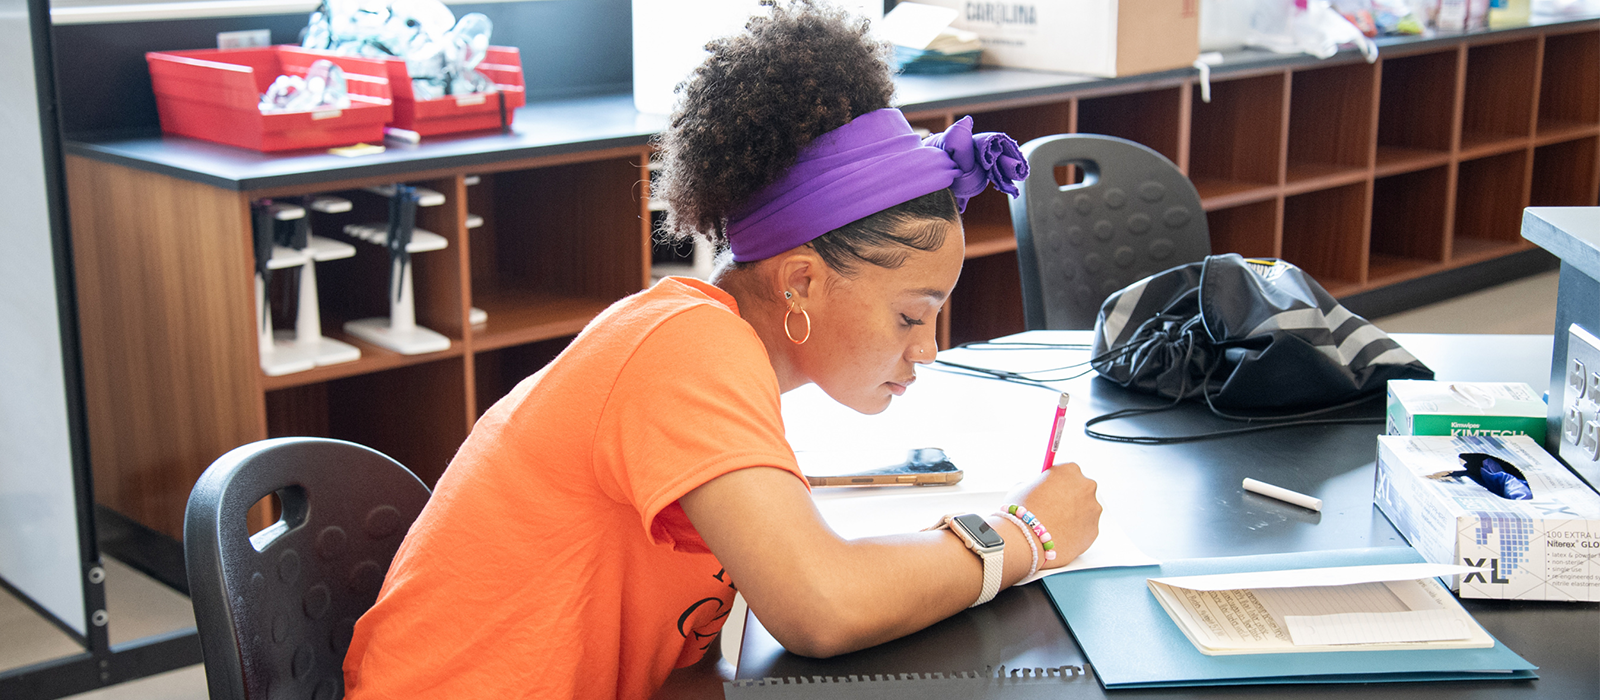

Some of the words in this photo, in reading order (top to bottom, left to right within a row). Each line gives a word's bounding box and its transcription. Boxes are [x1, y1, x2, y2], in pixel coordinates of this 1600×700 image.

[966, 2, 1037, 25] CAROLINA
[1450, 422, 1480, 430] Kimwipes
[1564, 531, 1592, 539] EXTRA
[1581, 540, 1600, 549] GLO
[1463, 558, 1509, 584] XL
